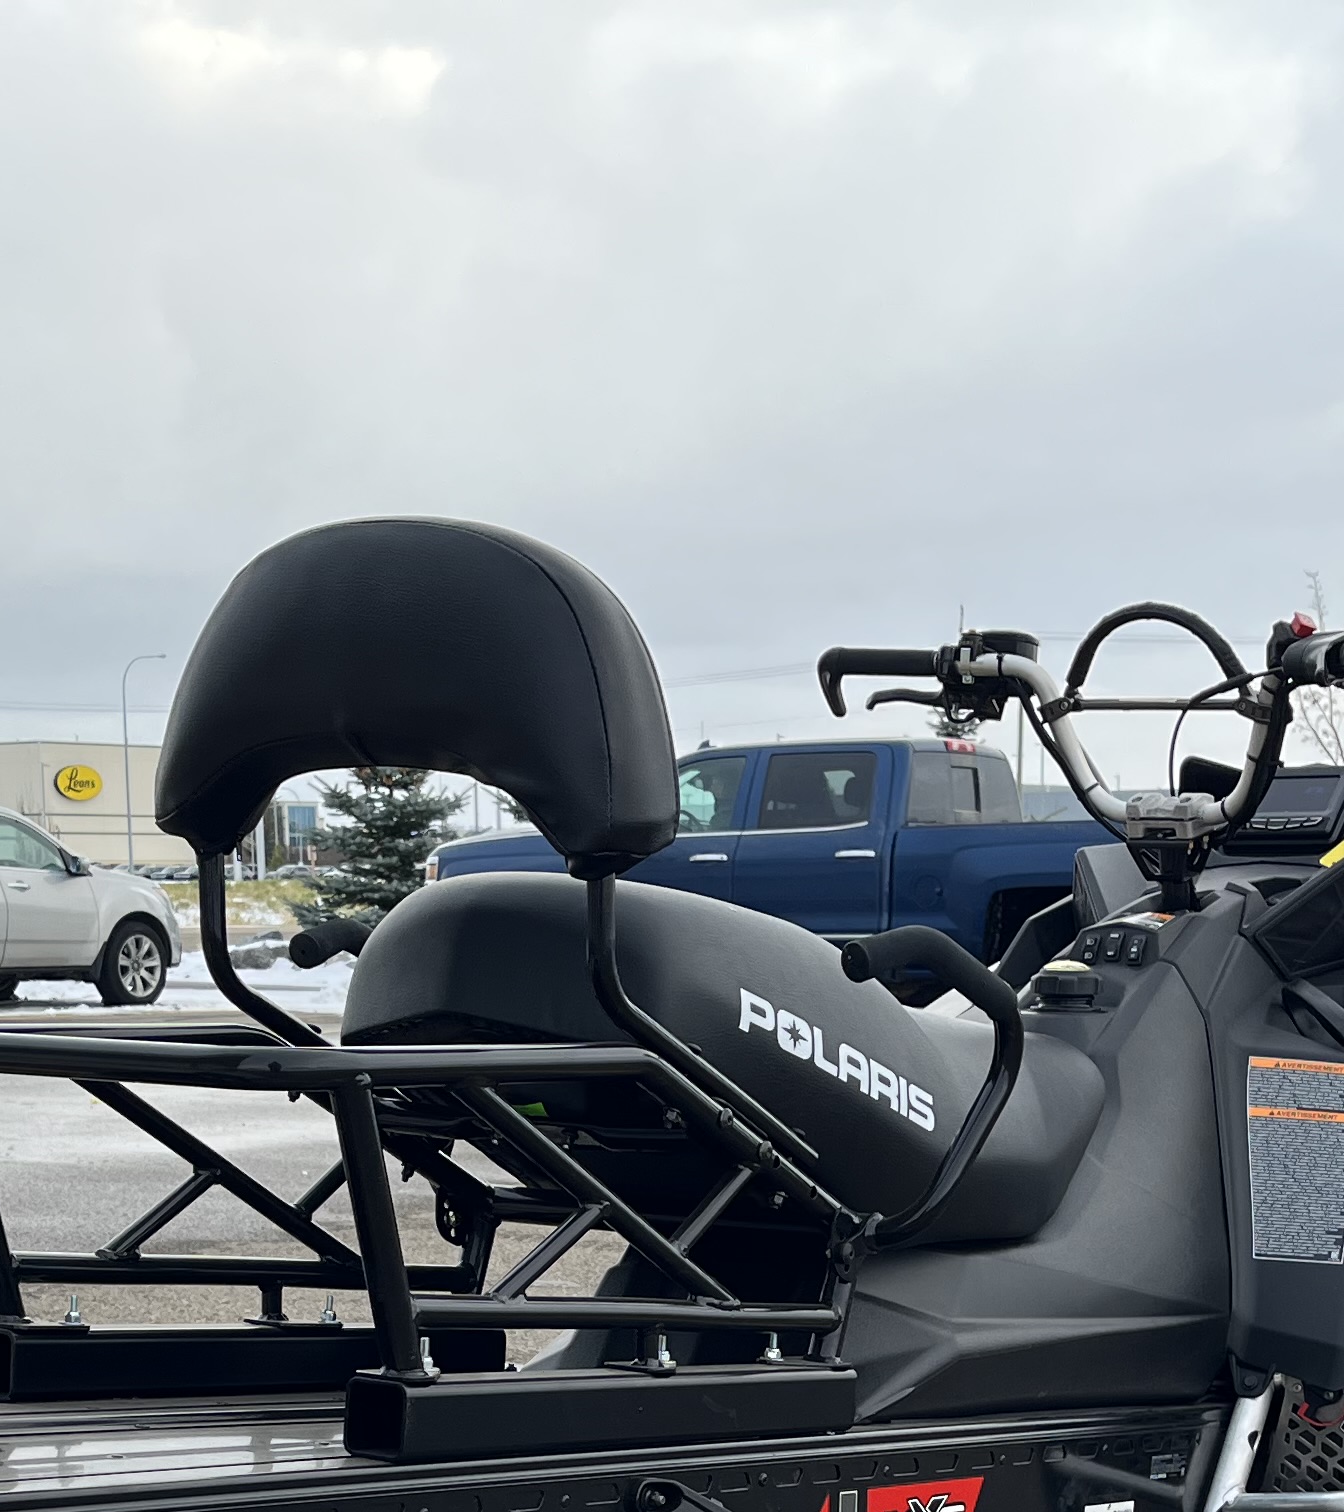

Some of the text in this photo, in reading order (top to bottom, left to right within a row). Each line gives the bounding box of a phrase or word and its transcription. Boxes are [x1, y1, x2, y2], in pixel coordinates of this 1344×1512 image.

[738, 987, 936, 1132] POLARIS
[1281, 1062, 1344, 1073] AVERTISSEMENT
[1276, 1111, 1339, 1120] AVERTISSEMENT
